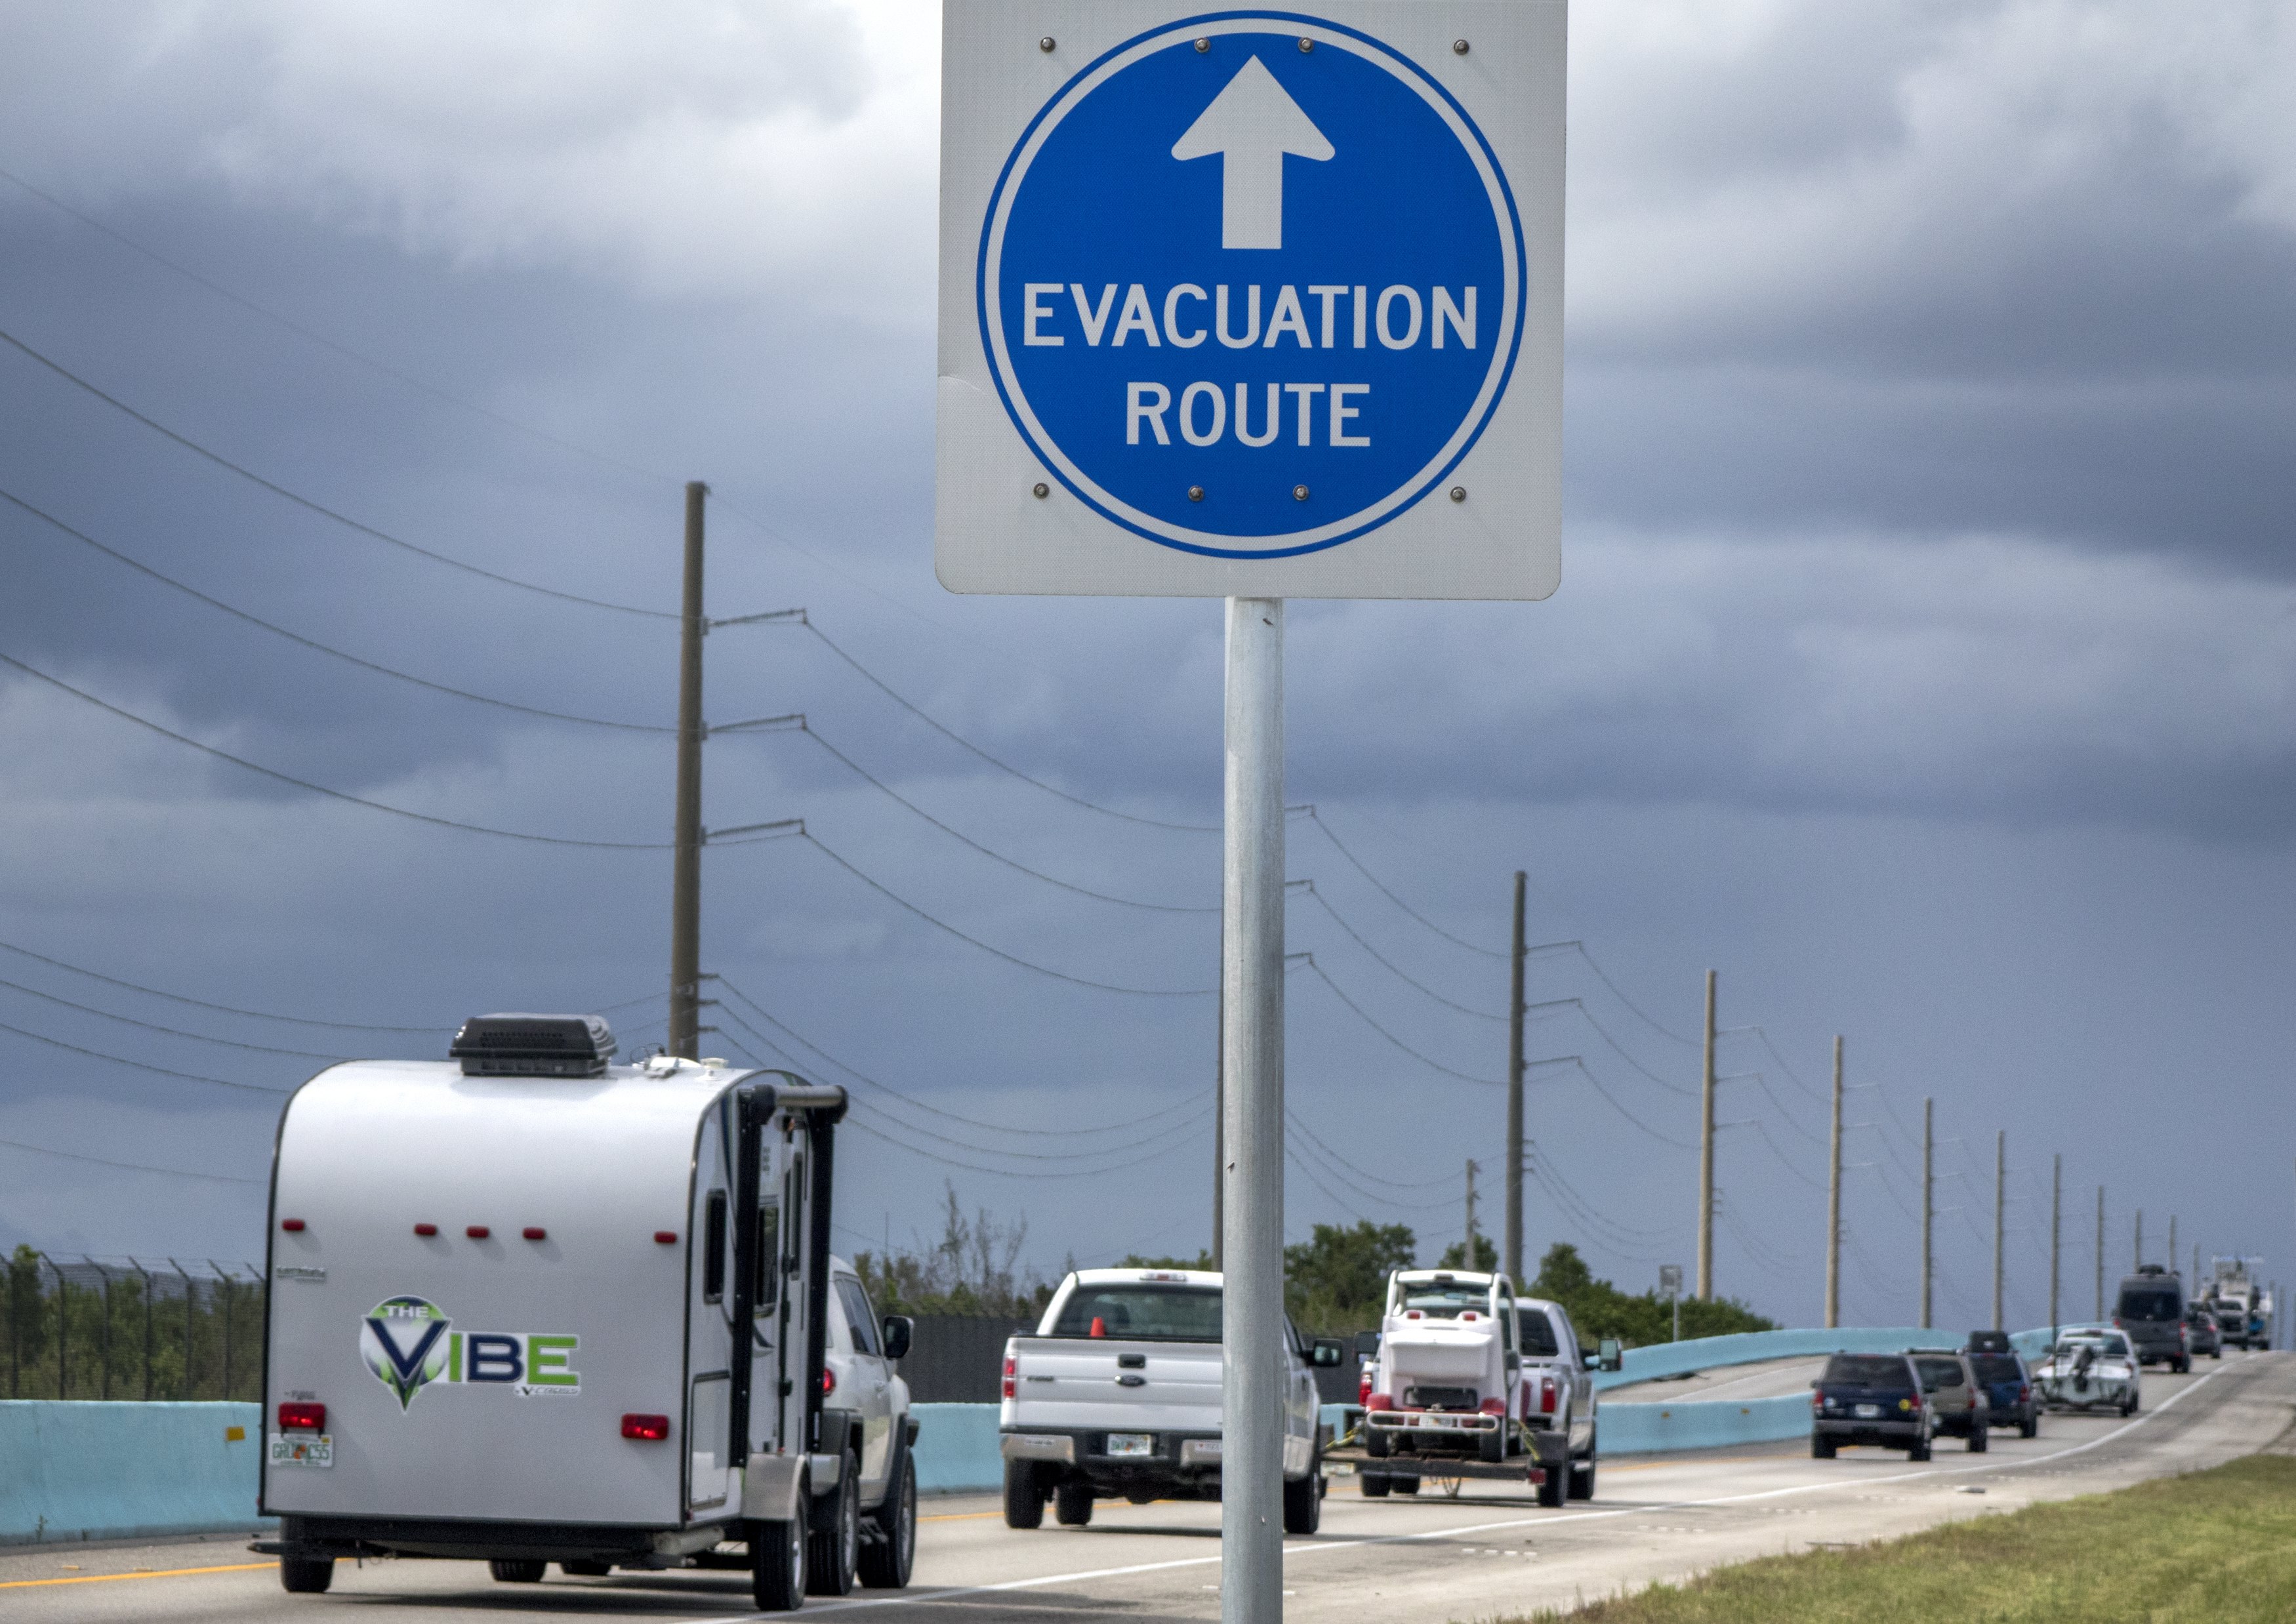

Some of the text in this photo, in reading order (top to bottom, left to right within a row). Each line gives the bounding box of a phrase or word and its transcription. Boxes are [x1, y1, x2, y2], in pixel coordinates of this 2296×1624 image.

[1023, 283, 1477, 350] EVACUATION
[1126, 381, 1370, 447] ROUTE
[384, 1305, 429, 1318] THE
[365, 1317, 579, 1402] VIBE
